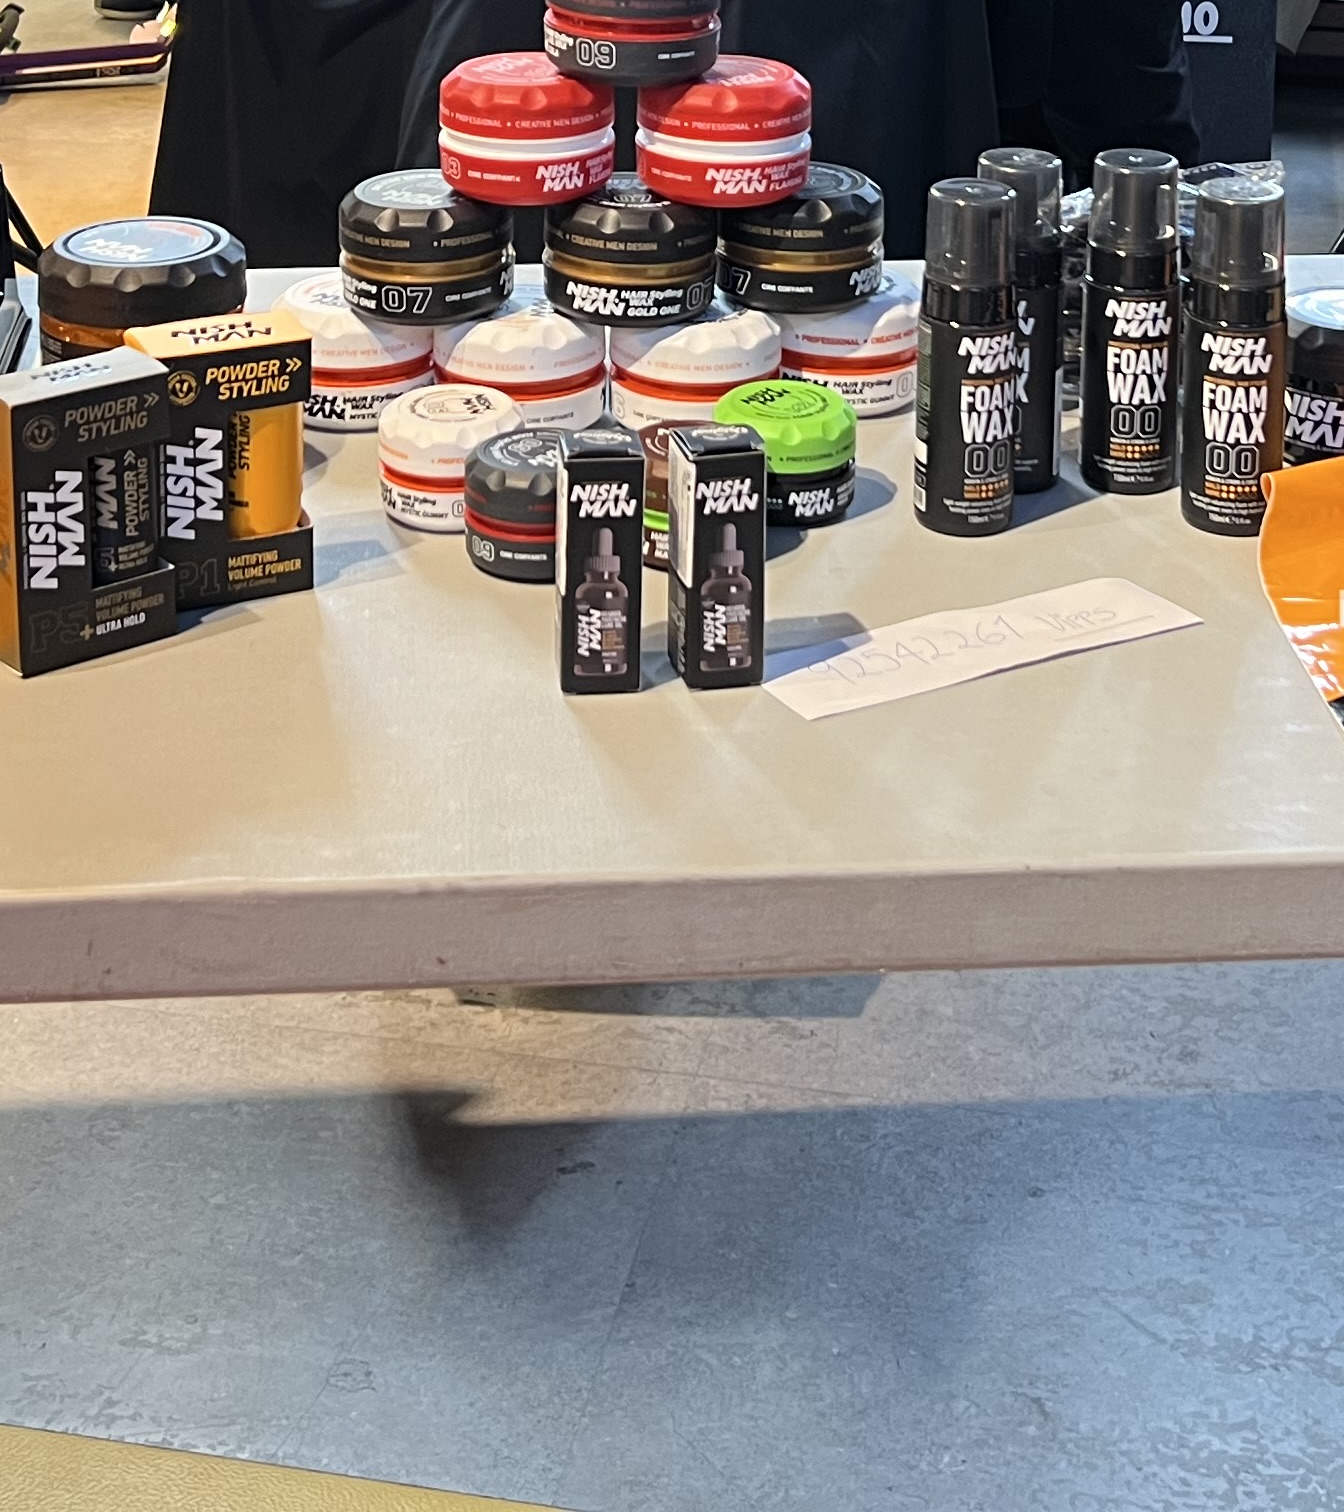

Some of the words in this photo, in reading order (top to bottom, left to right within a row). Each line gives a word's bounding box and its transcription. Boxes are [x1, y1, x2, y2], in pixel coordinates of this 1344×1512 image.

[575, 37, 617, 70] 09
[691, 121, 750, 132] PROFESSIONAL
[535, 161, 580, 182] NISH
[542, 173, 585, 193] MAN
[705, 167, 762, 184] NISH
[712, 178, 767, 195] MAN
[570, 235, 605, 250] CREATIVE
[606, 240, 625, 251] MEN
[626, 241, 658, 252] DESIGN
[381, 285, 433, 314] 07
[566, 281, 616, 302] NISH
[620, 289, 649, 300] HAIR
[572, 296, 626, 317] MAN
[1104, 299, 1167, 320] NISH
[1113, 316, 1173, 338] MAN
[957, 331, 1016, 357] NISH
[1201, 332, 1267, 356] NISH
[204, 358, 281, 386] POWDER
[966, 350, 1017, 375] MAN
[1107, 346, 1168, 375] FOAM
[1208, 353, 1273, 375] MAN
[217, 374, 291, 401] STYLING
[1107, 371, 1168, 405] WAX
[1202, 380, 1268, 413] FOAM
[64, 394, 139, 428] POWDER
[960, 404, 1014, 444] WAX
[1110, 404, 1162, 439] 00
[1202, 406, 1266, 444] WAX
[76, 411, 149, 443] STYLING
[237, 414, 251, 472] STYLING
[964, 439, 1010, 478] 00
[1205, 441, 1260, 479] 00
[194, 426, 225, 522] MAN
[94, 456, 120, 530] MAN
[138, 455, 151, 523] STYLING
[166, 443, 197, 541] NISH
[570, 483, 631, 502] NISH
[696, 477, 752, 500] NISH
[787, 487, 831, 505] NISH
[125, 469, 140, 537] POWDER
[578, 498, 638, 518] MAN
[703, 492, 759, 515] MAN
[794, 498, 835, 518] MAN
[54, 469, 87, 567] MAN
[27, 490, 60, 590] NISH
[471, 534, 495, 562] 09
[227, 549, 279, 569] MATTIFYING
[227, 563, 264, 582] VOLUME
[264, 558, 302, 576] POWDER
[95, 586, 143, 608] MATTIFYING
[95, 601, 130, 623] VOLUME
[130, 593, 165, 612] POWDER
[95, 616, 123, 636] ULTRA
[123, 612, 146, 629] HOLD
[577, 613, 591, 657] NISH
[589, 608, 602, 651] MAN
[703, 610, 716, 652] NISH
[714, 604, 727, 646] MAN
